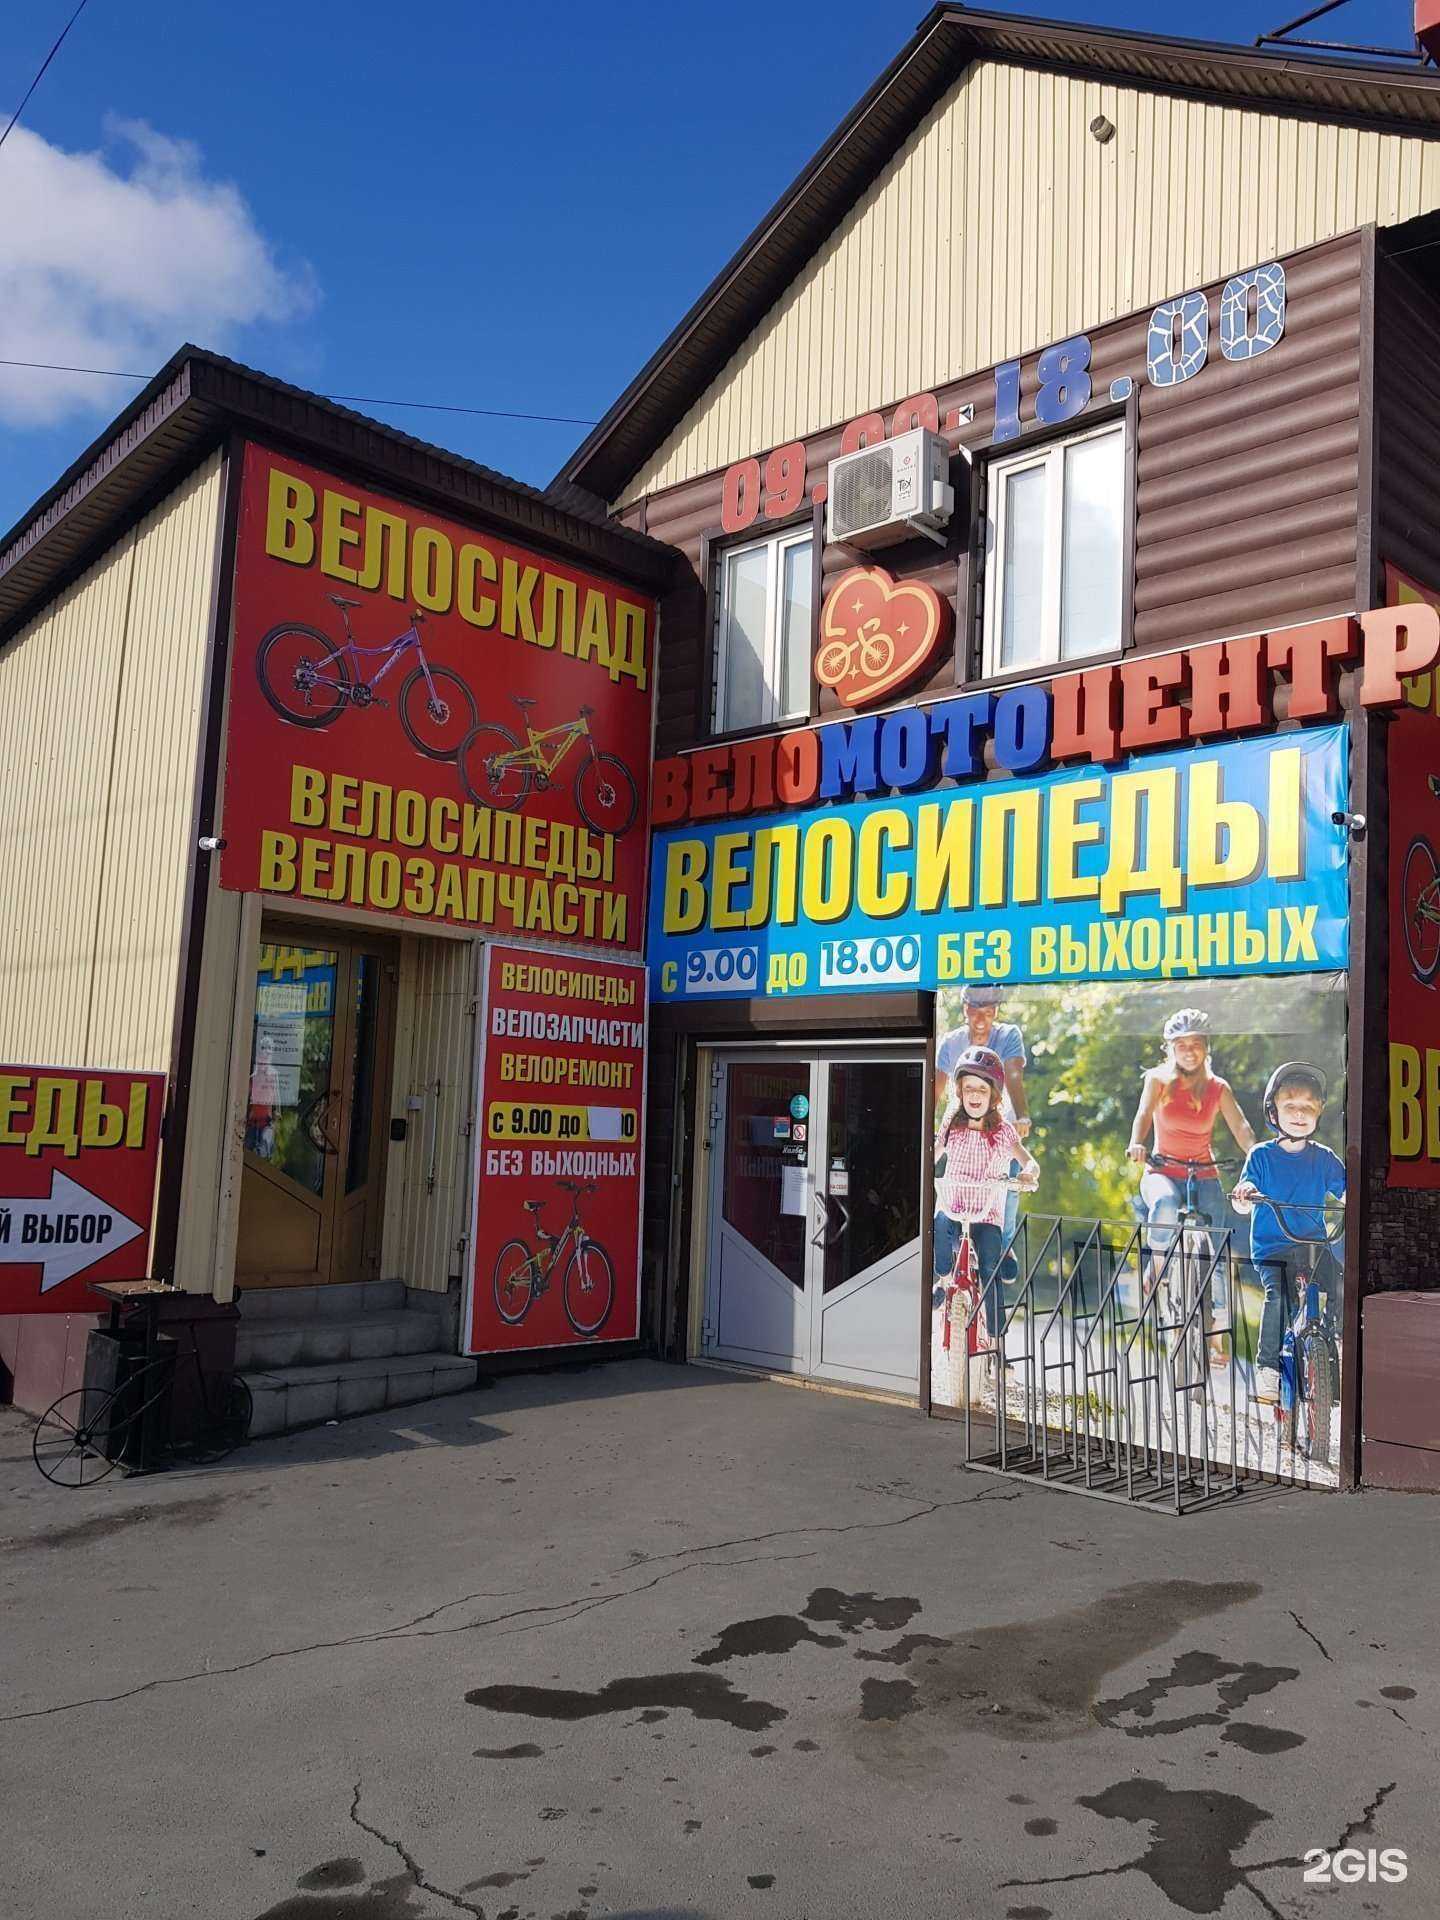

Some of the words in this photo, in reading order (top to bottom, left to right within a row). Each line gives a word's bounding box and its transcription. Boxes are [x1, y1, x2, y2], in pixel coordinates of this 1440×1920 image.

[265, 467, 647, 691] ВЕЛОСКЛАД
[652, 602, 1440, 826] ВЕЛОМОТОЦЕНТР
[290, 764, 614, 887] ВЕЛОСИПЕДЫ
[662, 747, 1303, 934] ВЕЛОСИПЕДЫ
[259, 829, 628, 942] ВЕЛОЗАПЧАСТИ
[687, 948, 757, 983] 9.00
[766, 952, 807, 994] до
[821, 935, 920, 977] 18.00
[937, 931, 1012, 980] БЕЗ
[1031, 905, 1319, 978] ВЫХОДНЫХ
[501, 962, 636, 1006] ВЕЛОСИПЕДЫ
[491, 1007, 644, 1048] ВЕЛОЗАПЧАСТИ
[500, 1053, 634, 1088] ВЕЛОРЕМОНТ
[511, 1108, 552, 1134] 9.00
[558, 1115, 580, 1138] до
[485, 1149, 523, 1176] БЕЗ
[531, 1151, 636, 1179] ВЫХОДНЫХ
[21, 1214, 113, 1243] ВЫБОР
